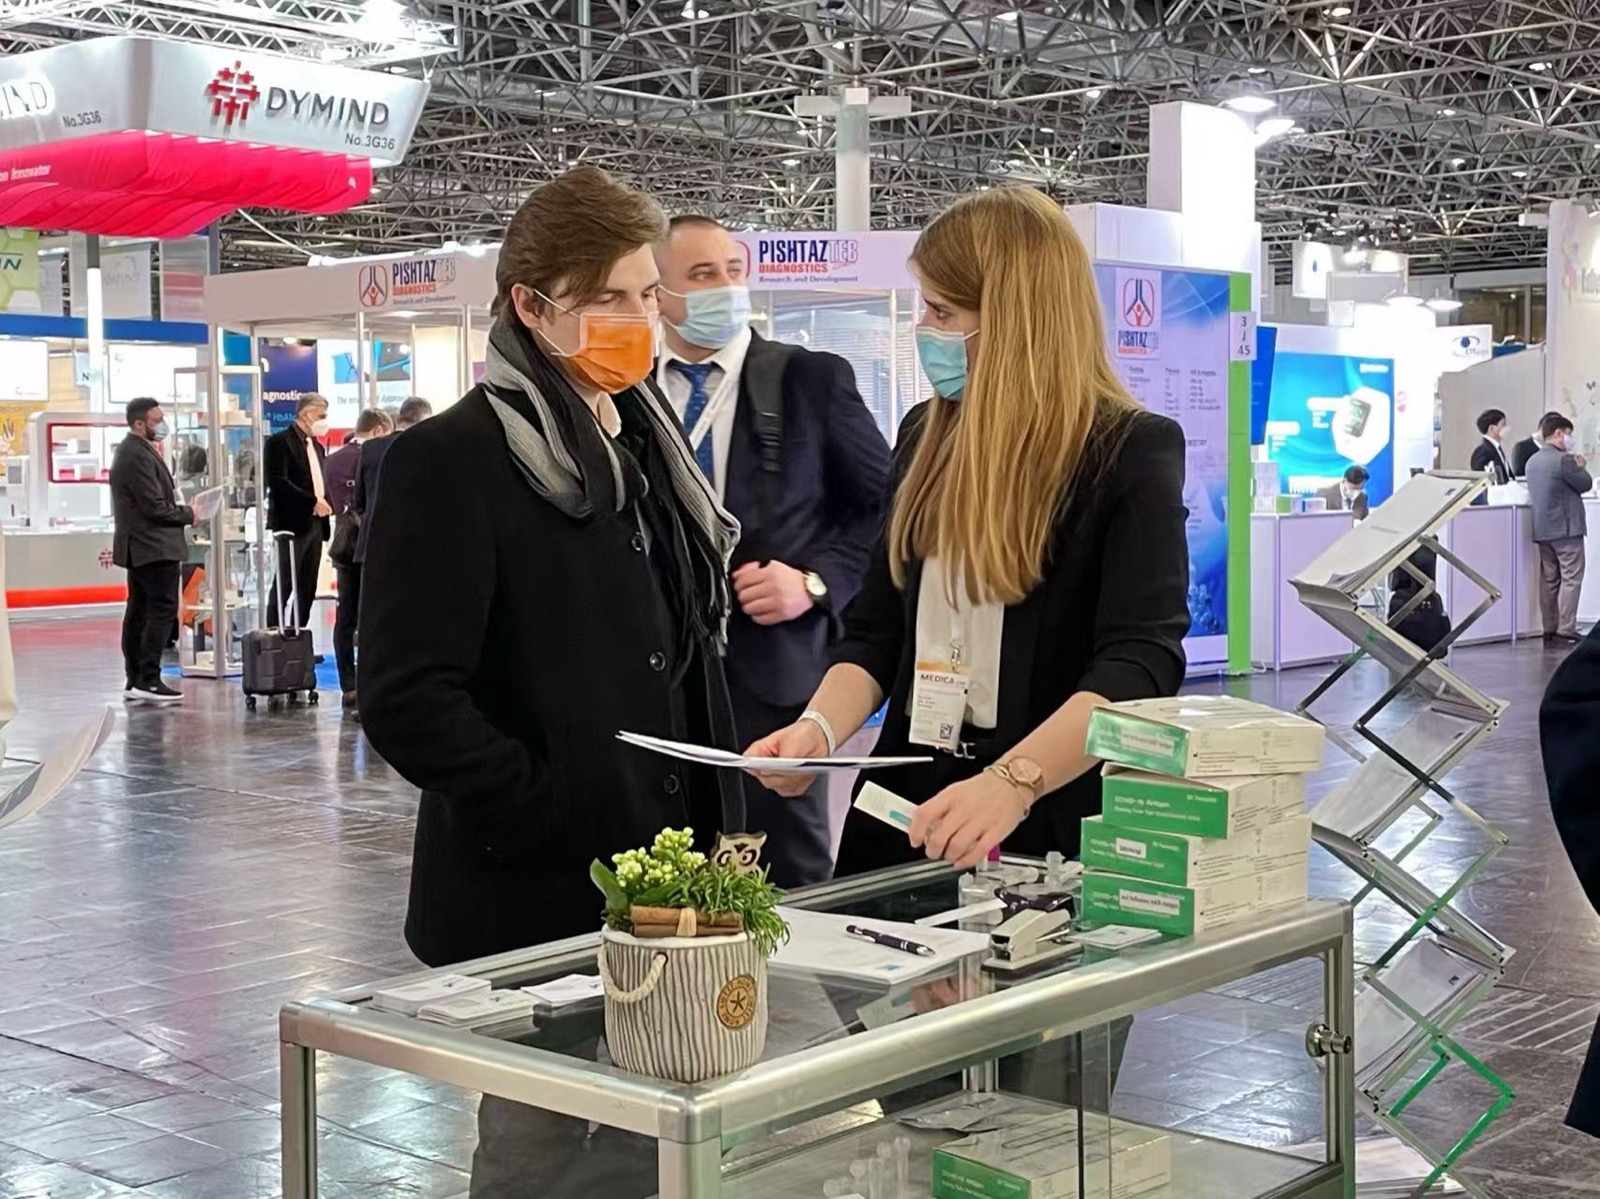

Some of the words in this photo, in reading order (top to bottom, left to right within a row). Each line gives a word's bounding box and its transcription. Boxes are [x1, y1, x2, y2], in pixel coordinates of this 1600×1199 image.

[0, 82, 47, 116] IND
[266, 86, 389, 125] DYMIND
[62, 110, 102, 128] No.3G36
[345, 132, 396, 150] No.3G36
[0, 258, 22, 271] N
[758, 263, 829, 274] DIAGNOSTICS
[759, 275, 792, 283] Research
[793, 275, 808, 283] and
[809, 275, 858, 284] Development
[1241, 316, 1247, 327] 3
[1237, 345, 1251, 356] 45
[263, 389, 301, 403] agnostic
[920, 673, 955, 685] MEDICA
